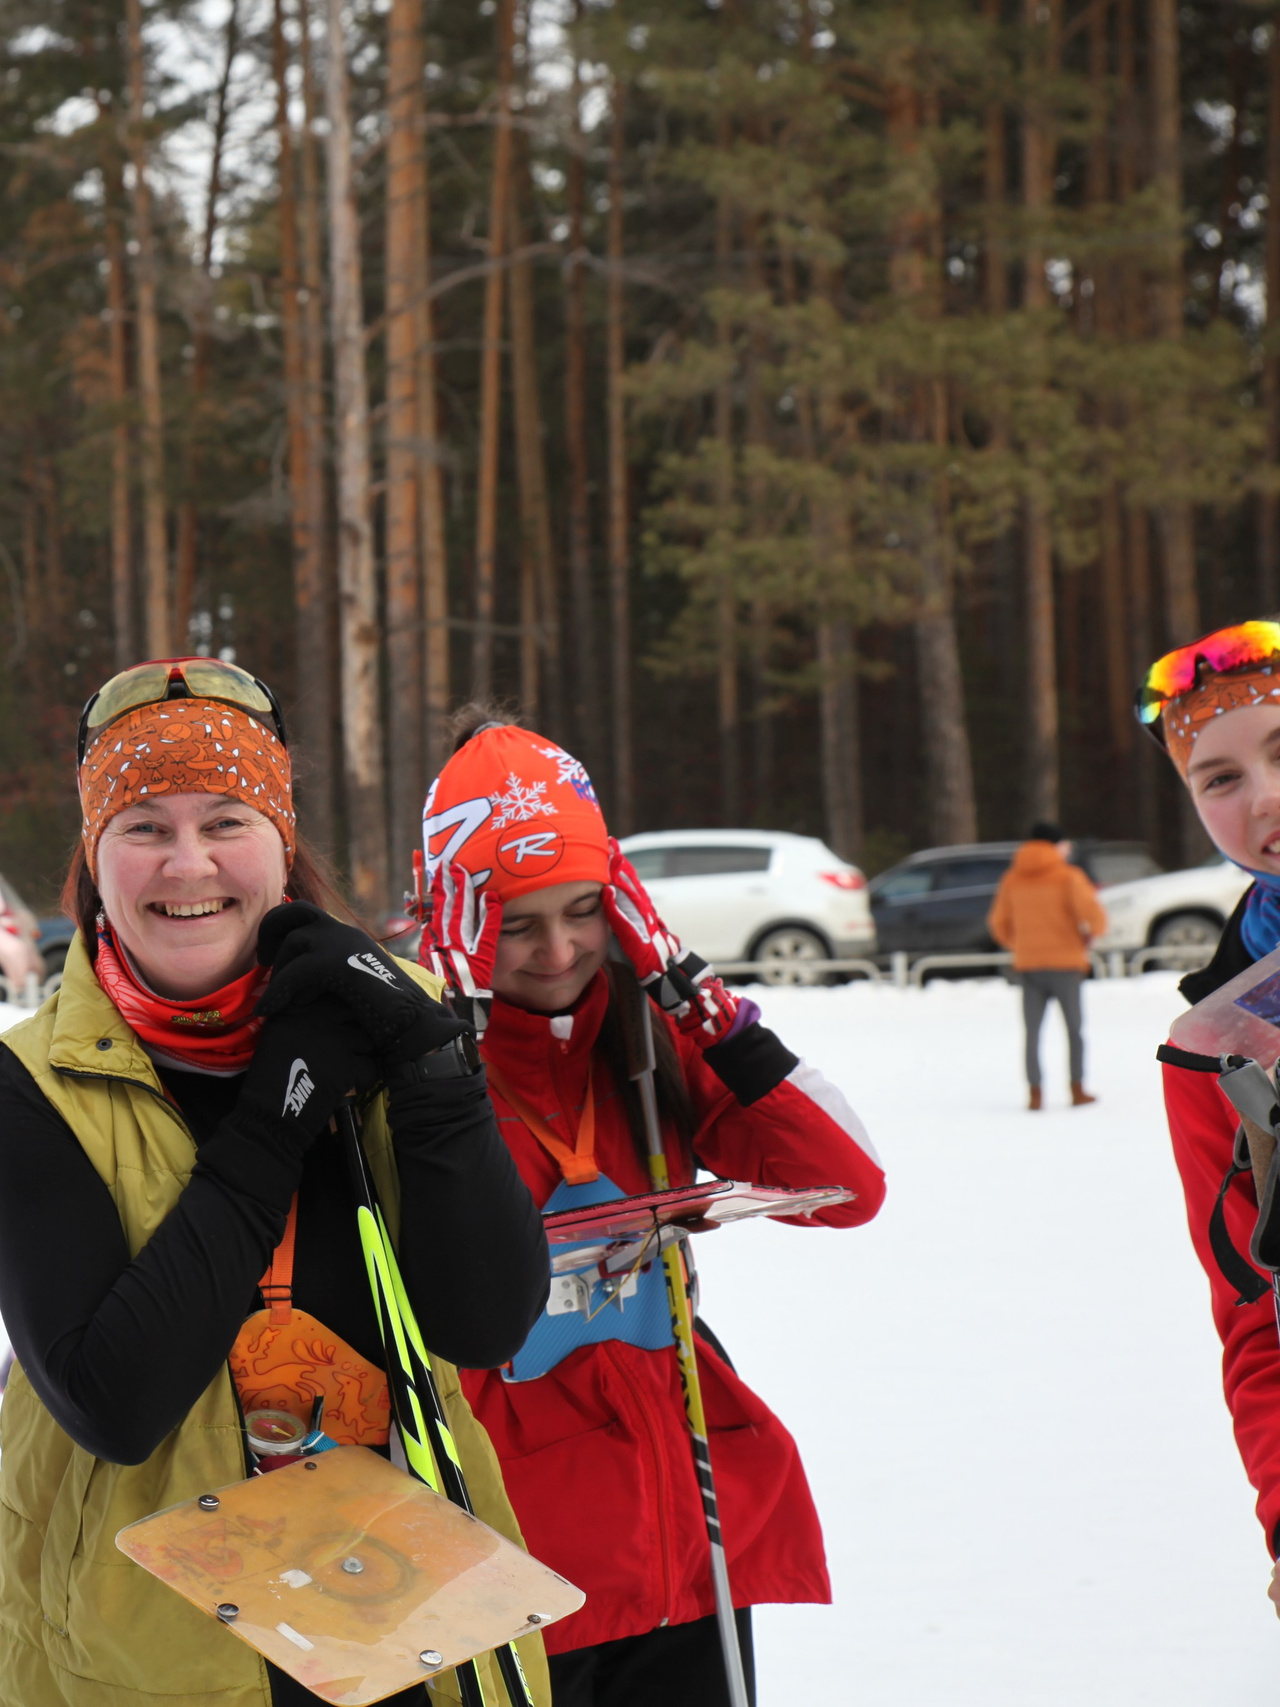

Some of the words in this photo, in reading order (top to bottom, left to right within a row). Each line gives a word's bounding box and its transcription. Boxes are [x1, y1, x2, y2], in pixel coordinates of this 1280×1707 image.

[500, 831, 558, 864] R
[361, 952, 397, 982] NIKE
[287, 1072, 315, 1117] NIKE
